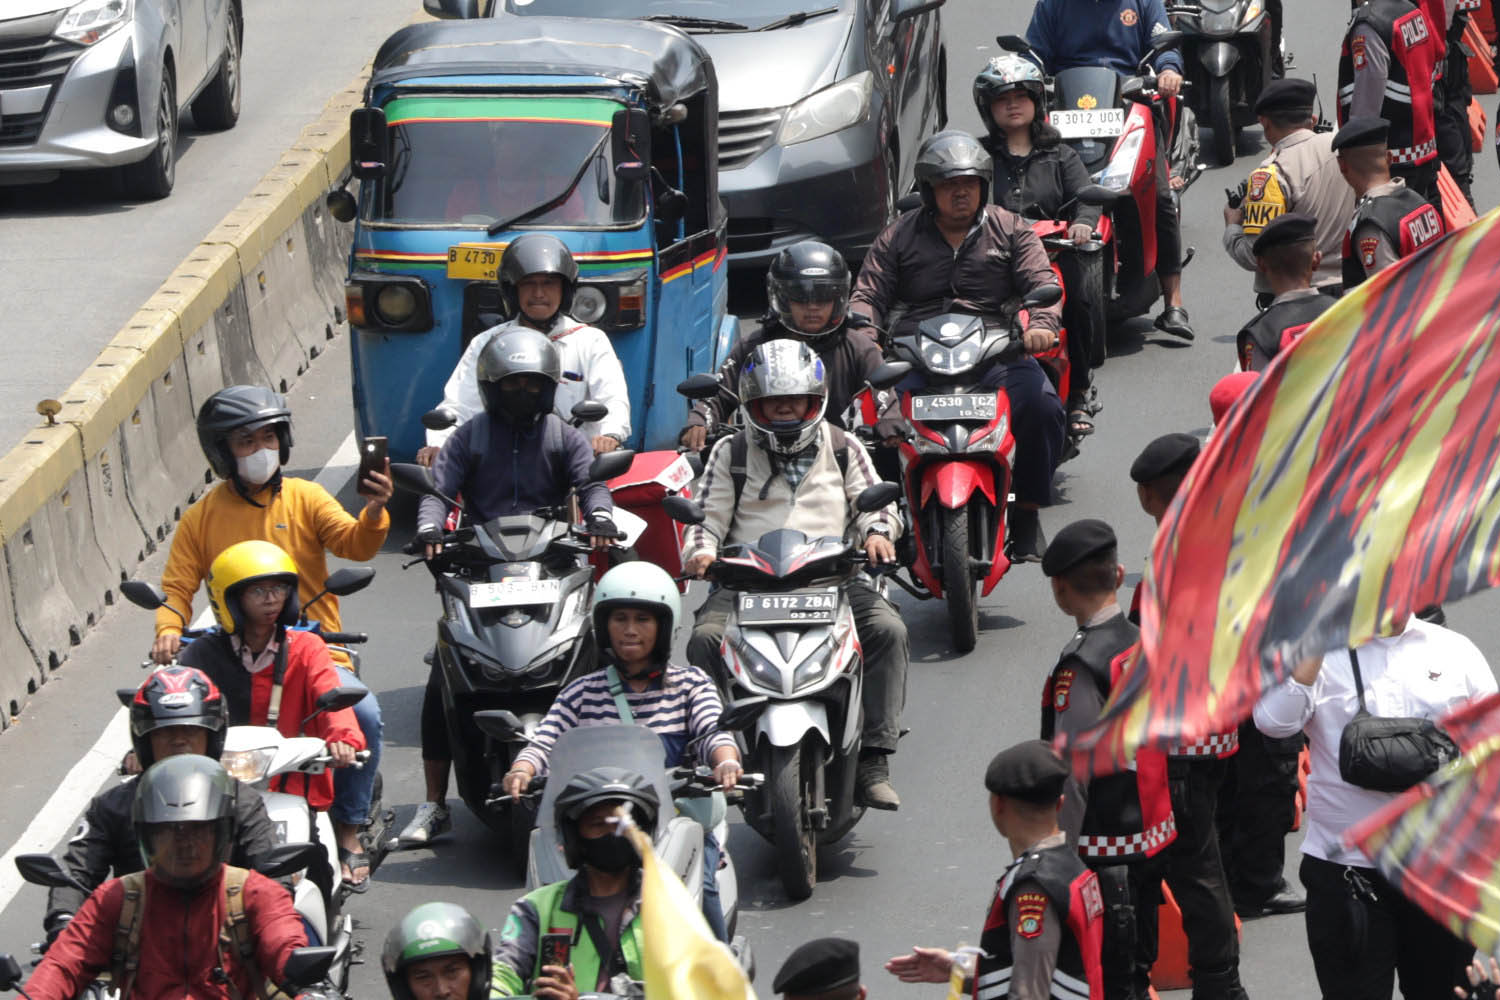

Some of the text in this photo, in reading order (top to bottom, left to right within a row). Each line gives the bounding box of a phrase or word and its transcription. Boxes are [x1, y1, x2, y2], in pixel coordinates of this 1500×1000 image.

[1053, 114, 1059, 125] B
[1065, 113, 1093, 124] 3012
[1408, 207, 1440, 247] POLISI
[450, 249, 496, 264] B 4730
[915, 398, 923, 408] B
[931, 397, 963, 407] 4530
[745, 598, 754, 609] B
[762, 597, 798, 608] 6172
